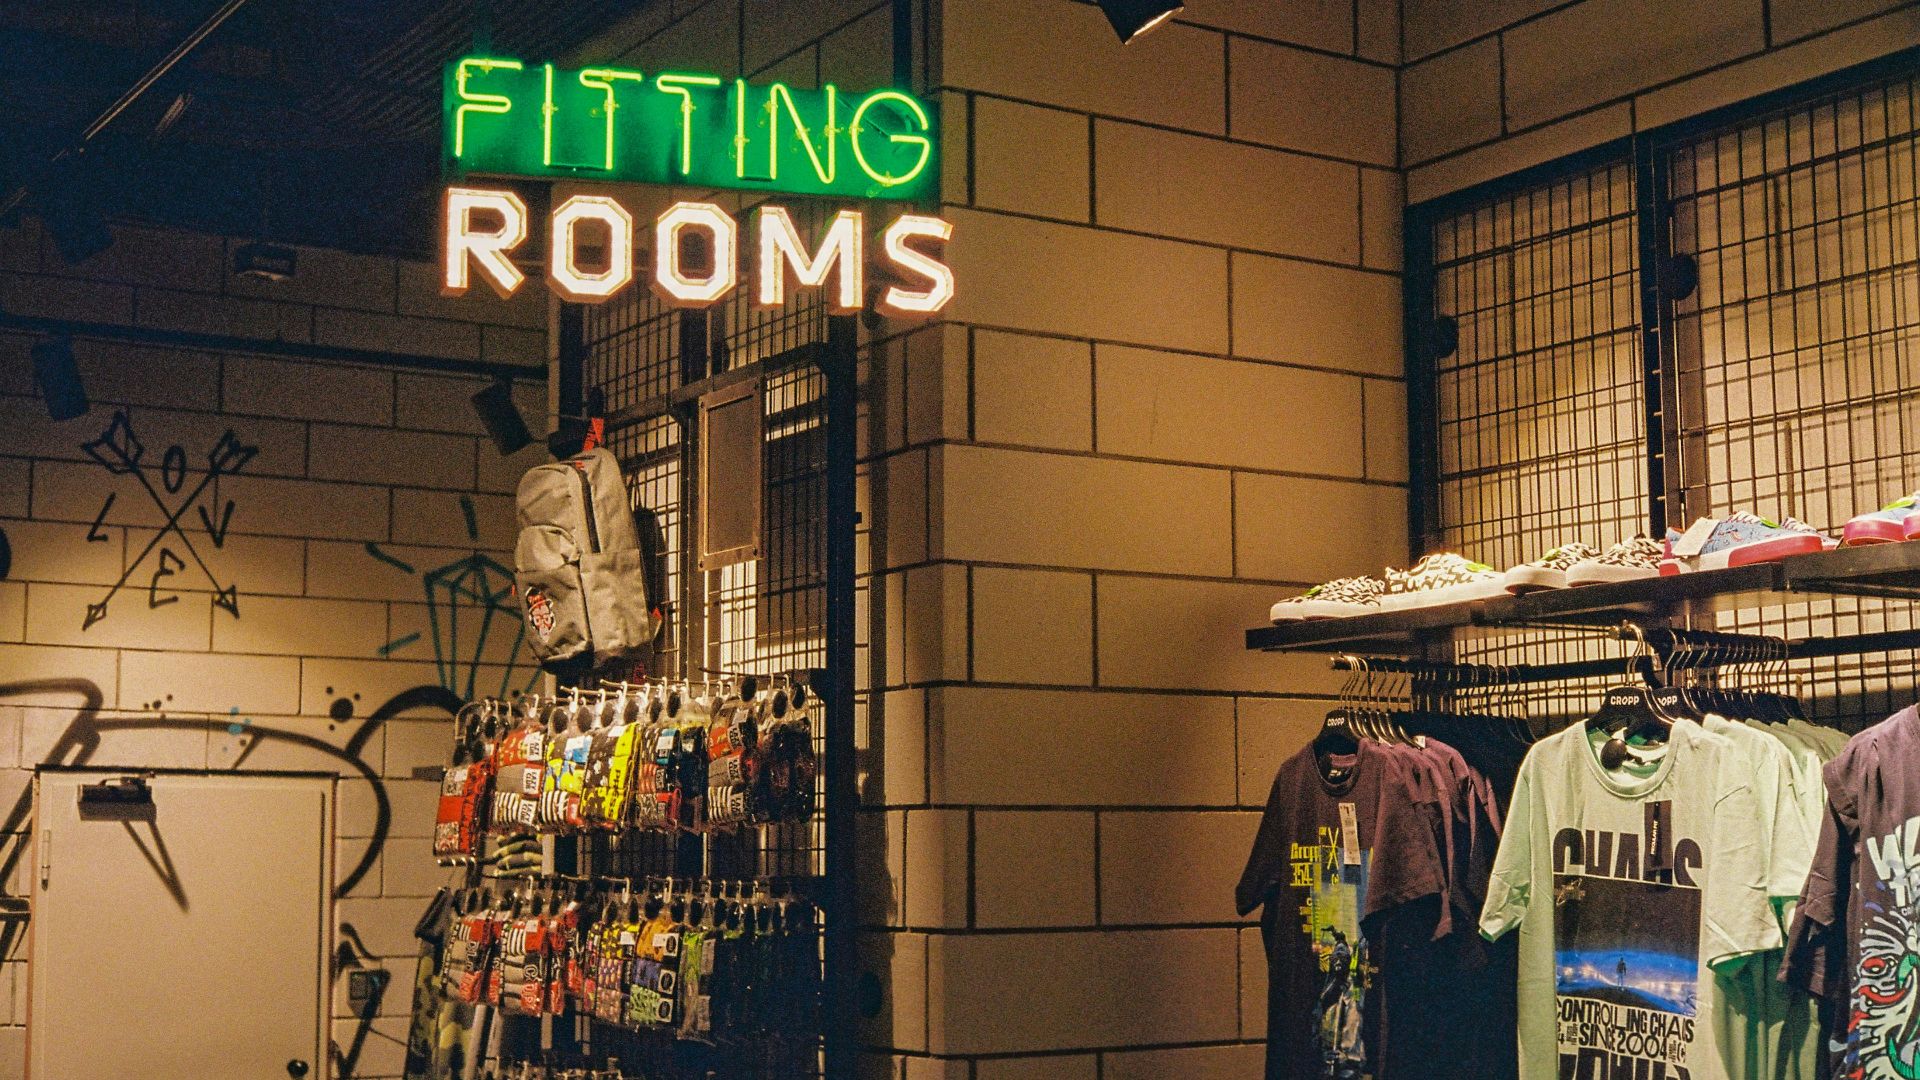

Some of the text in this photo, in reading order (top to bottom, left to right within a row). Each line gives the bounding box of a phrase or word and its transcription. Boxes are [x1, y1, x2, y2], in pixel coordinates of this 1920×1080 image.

[455, 58, 930, 185] FITTING
[444, 187, 954, 314] ROOMS
[1610, 695, 1640, 706] CROPP
[1616, 1028, 1668, 1061] 2004
